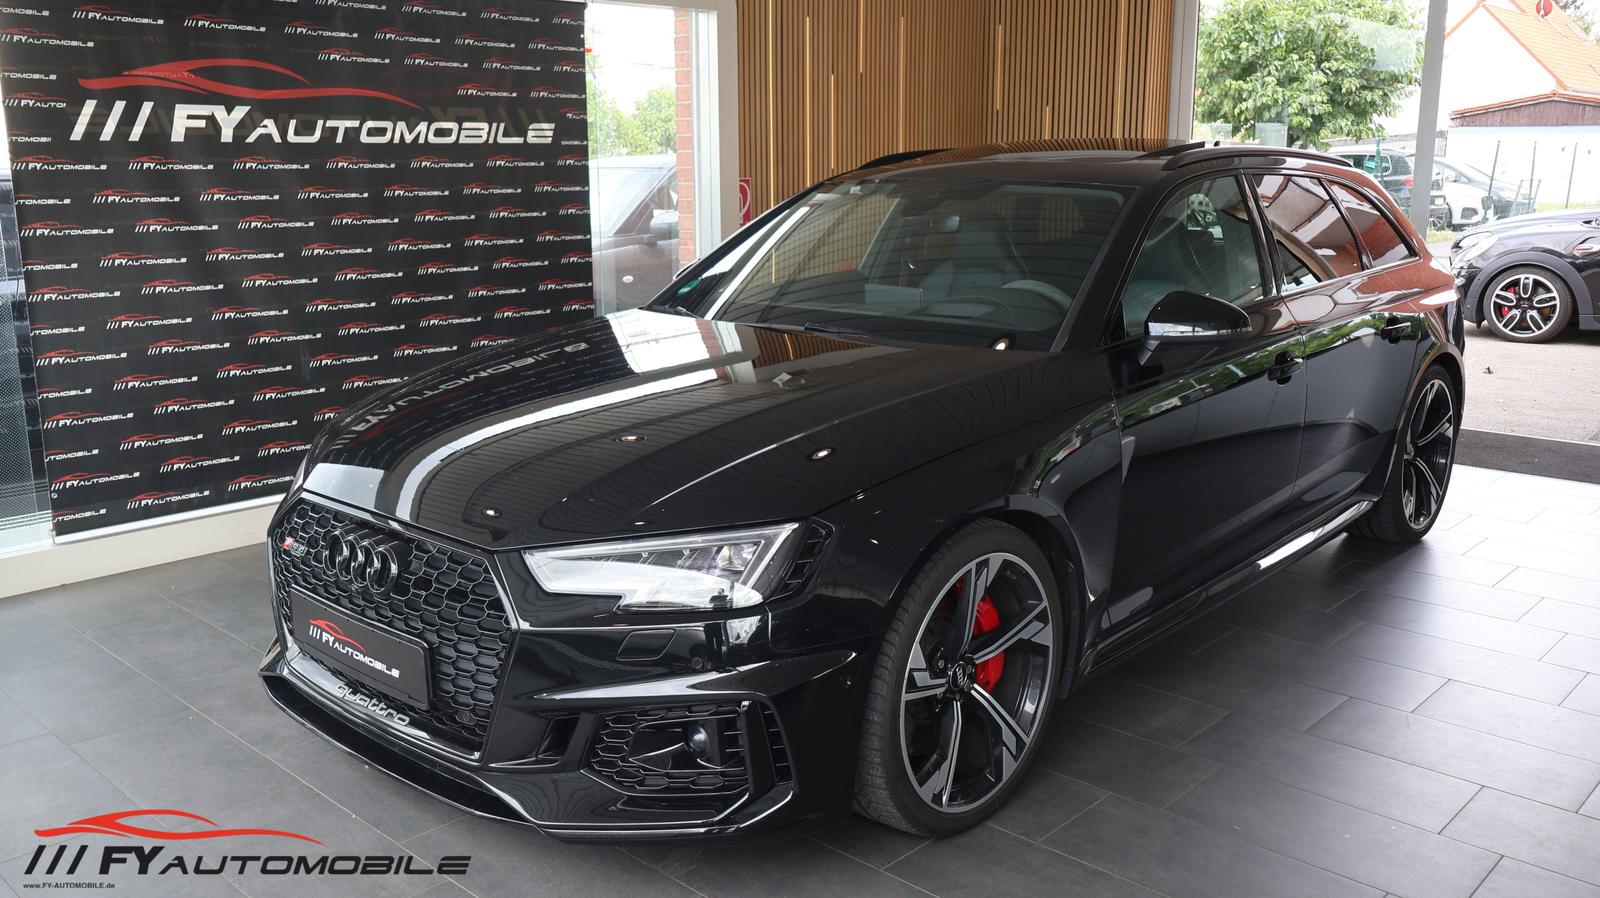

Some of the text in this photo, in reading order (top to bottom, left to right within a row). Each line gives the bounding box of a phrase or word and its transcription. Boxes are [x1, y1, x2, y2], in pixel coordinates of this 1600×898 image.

[327, 0, 386, 10] FYAUTOMOBILE
[87, 12, 164, 24] FYAUTOMOBILE
[198, 21, 266, 32] FYAUTOMOBILE
[297, 28, 358, 38] FYAUTOMOBILE
[14, 35, 94, 47] FYAUTOMOBILE
[330, 54, 390, 63] FYAUTOMOBILE
[171, 104, 555, 145] FYAUTOMOBILE
[36, 228, 114, 236] FYAUTOMOBILE
[115, 258, 187, 266] FYAUTOMOBILE
[346, 272, 403, 280] FYAUTOMOBILE
[155, 284, 224, 293] FYAUTOMOBILE
[255, 278, 318, 287] FYAUTOMOBILE
[44, 291, 120, 301] FYAUTOMOBILE
[318, 302, 376, 311] FYAUTOMOBILE
[225, 309, 288, 319] FYAUTOMOBILE
[121, 318, 192, 328] FYAUTOMOBILE
[349, 325, 405, 335] FYAUTOMOBILE
[260, 333, 322, 344] FYAUTOMOBILE
[162, 342, 230, 354] FYAUTOMOBILE
[51, 353, 127, 365] FYAUTOMOBILE
[321, 355, 378, 366] FYAUTOMOBILE
[229, 365, 292, 377] FYAUTOMOBILE
[127, 376, 198, 389] FYAUTOMOBILE
[265, 387, 327, 400] FYAUTOMOBILE
[168, 400, 235, 413] FYAUTOMOBILE
[59, 413, 134, 427] FYAUTOMOBILE
[235, 420, 297, 433] FYAUTOMOBILE
[134, 434, 203, 448] FYAUTOMOBILE
[173, 456, 240, 471] FYAUTOMOBILE
[66, 472, 140, 488] FYAUTOMOBILE
[141, 490, 210, 507] FYAUTOMOBILE
[322, 633, 400, 678] FYAUTOMOBILE
[335, 683, 410, 726] quattro
